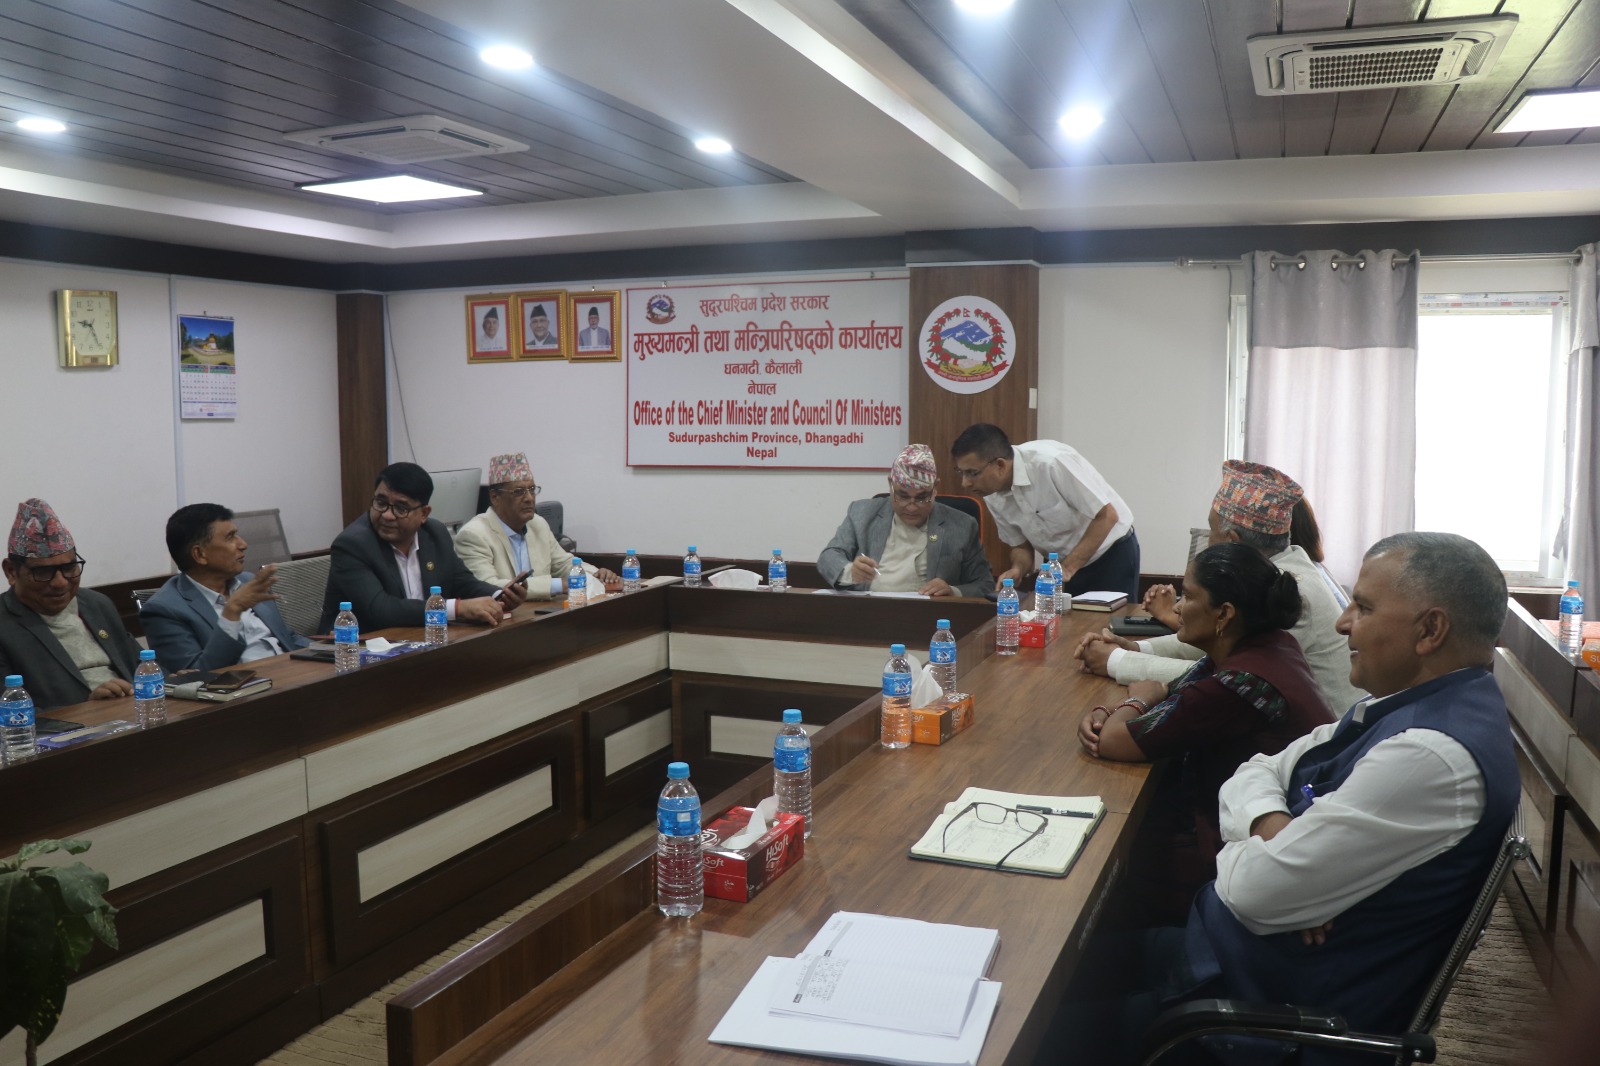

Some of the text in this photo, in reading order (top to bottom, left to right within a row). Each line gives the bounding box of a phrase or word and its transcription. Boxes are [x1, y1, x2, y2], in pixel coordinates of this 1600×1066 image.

[699, 293, 830, 317] सुदूरपश्चिम प्रदेश सरकार
[634, 320, 903, 360] मुख्यमन्त्री तथा मन्त्रिपरिषद्को कार्यालय
[765, 358, 802, 374] कैलाली
[747, 380, 777, 395] नेपाल
[634, 400, 902, 426] Office of the Chief Minister and Council Of Ministers
[668, 431, 864, 445] Sudurpashchim Province, Dhangadhi
[746, 447, 777, 459] Nepal
[765, 834, 789, 860] HiSoft
